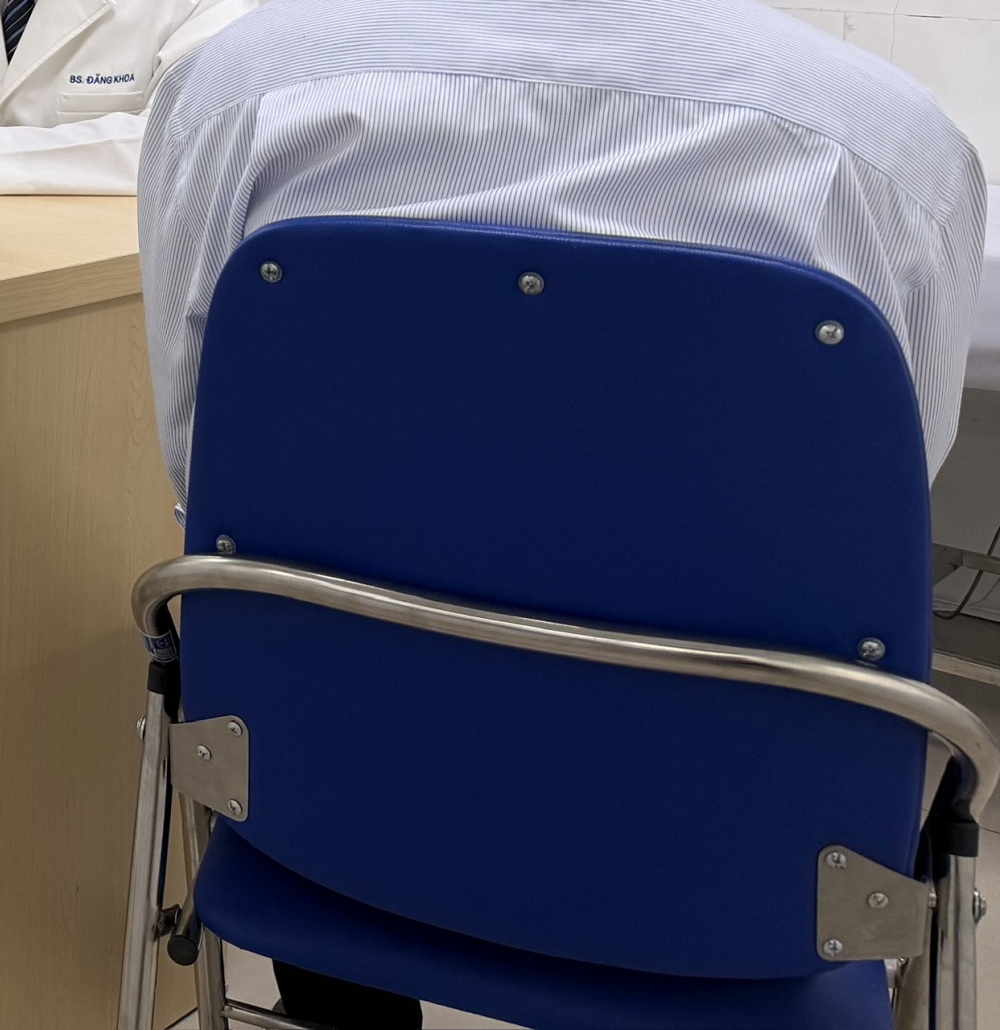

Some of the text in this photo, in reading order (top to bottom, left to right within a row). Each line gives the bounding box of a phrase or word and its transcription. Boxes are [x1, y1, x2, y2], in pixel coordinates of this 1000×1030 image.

[69, 73, 135, 85] BS. ĐĂNG KHOA
